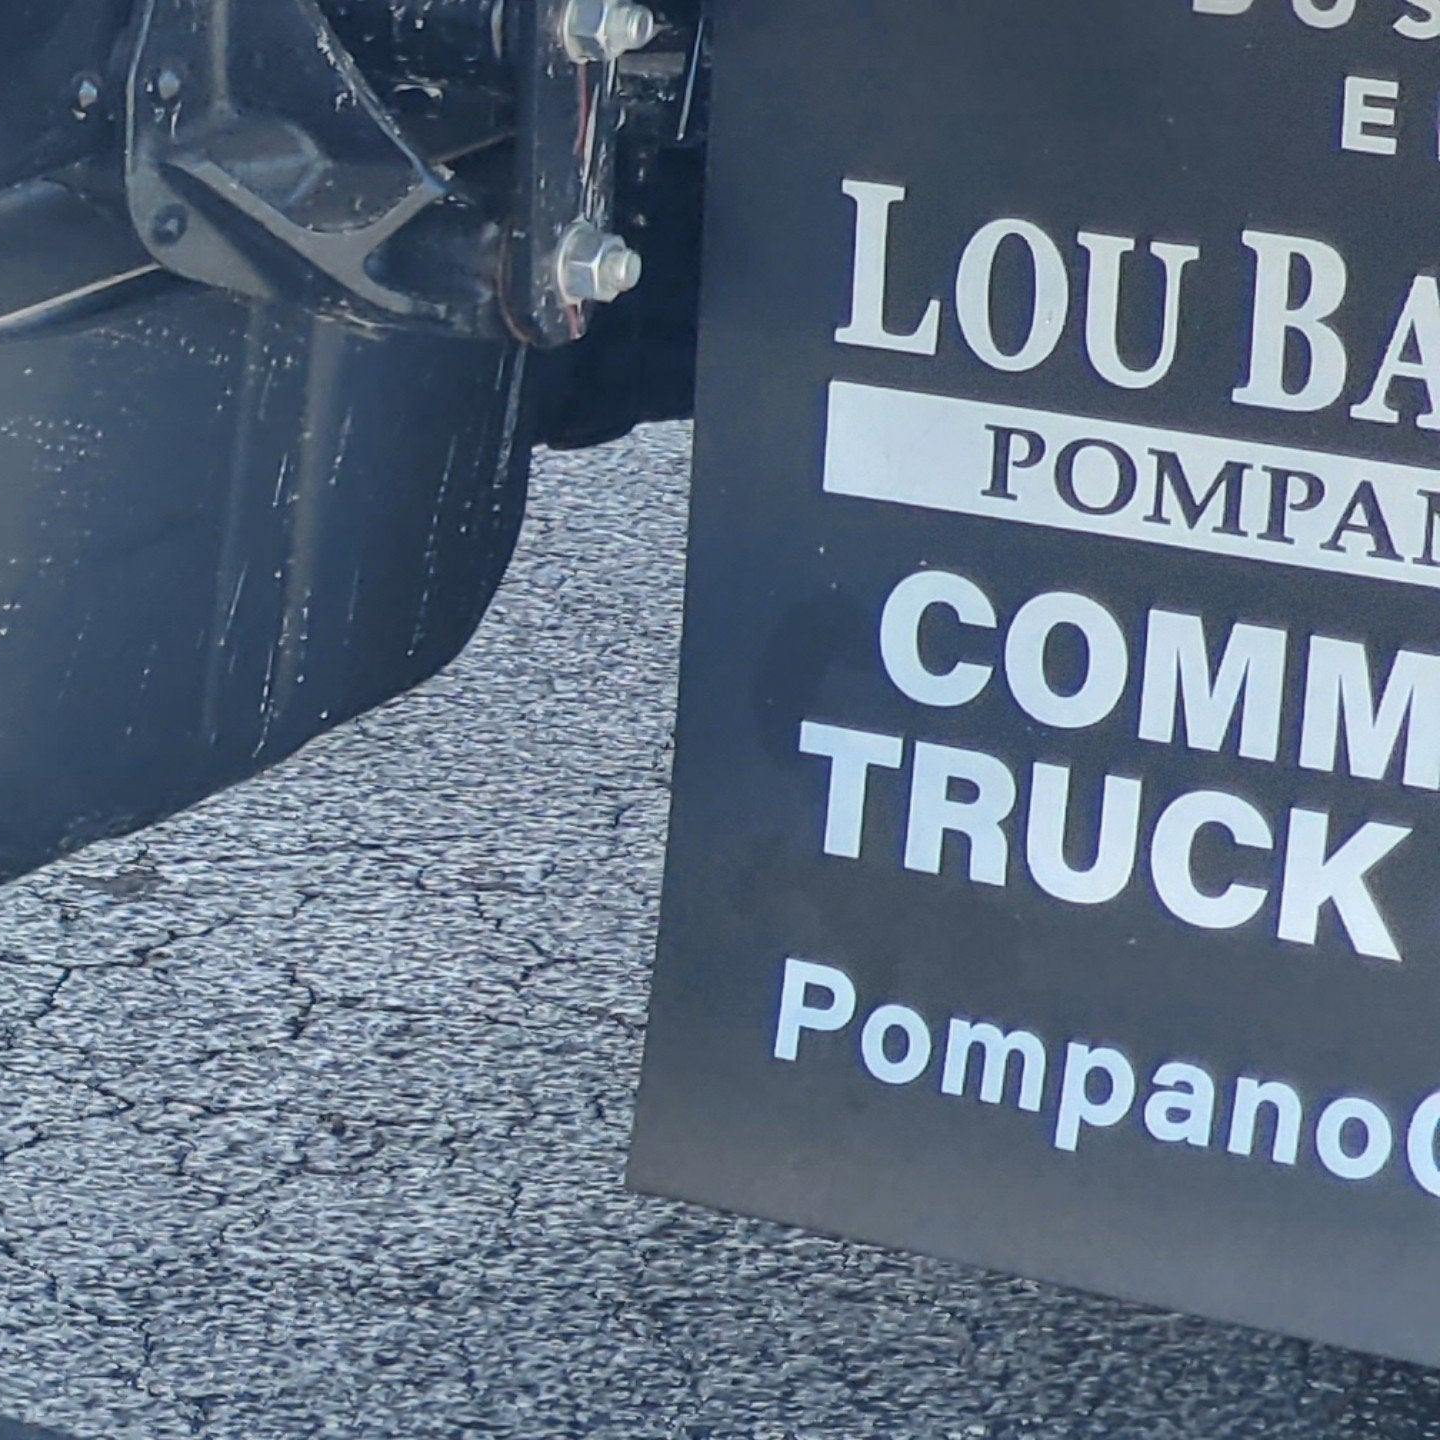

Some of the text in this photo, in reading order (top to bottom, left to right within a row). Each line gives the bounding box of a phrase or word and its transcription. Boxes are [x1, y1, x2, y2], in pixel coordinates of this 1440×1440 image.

[833, 178, 1201, 390] LOU
[980, 422, 1440, 567] POMPA
[879, 570, 1440, 792] COMM
[798, 720, 1413, 962] TRUCK
